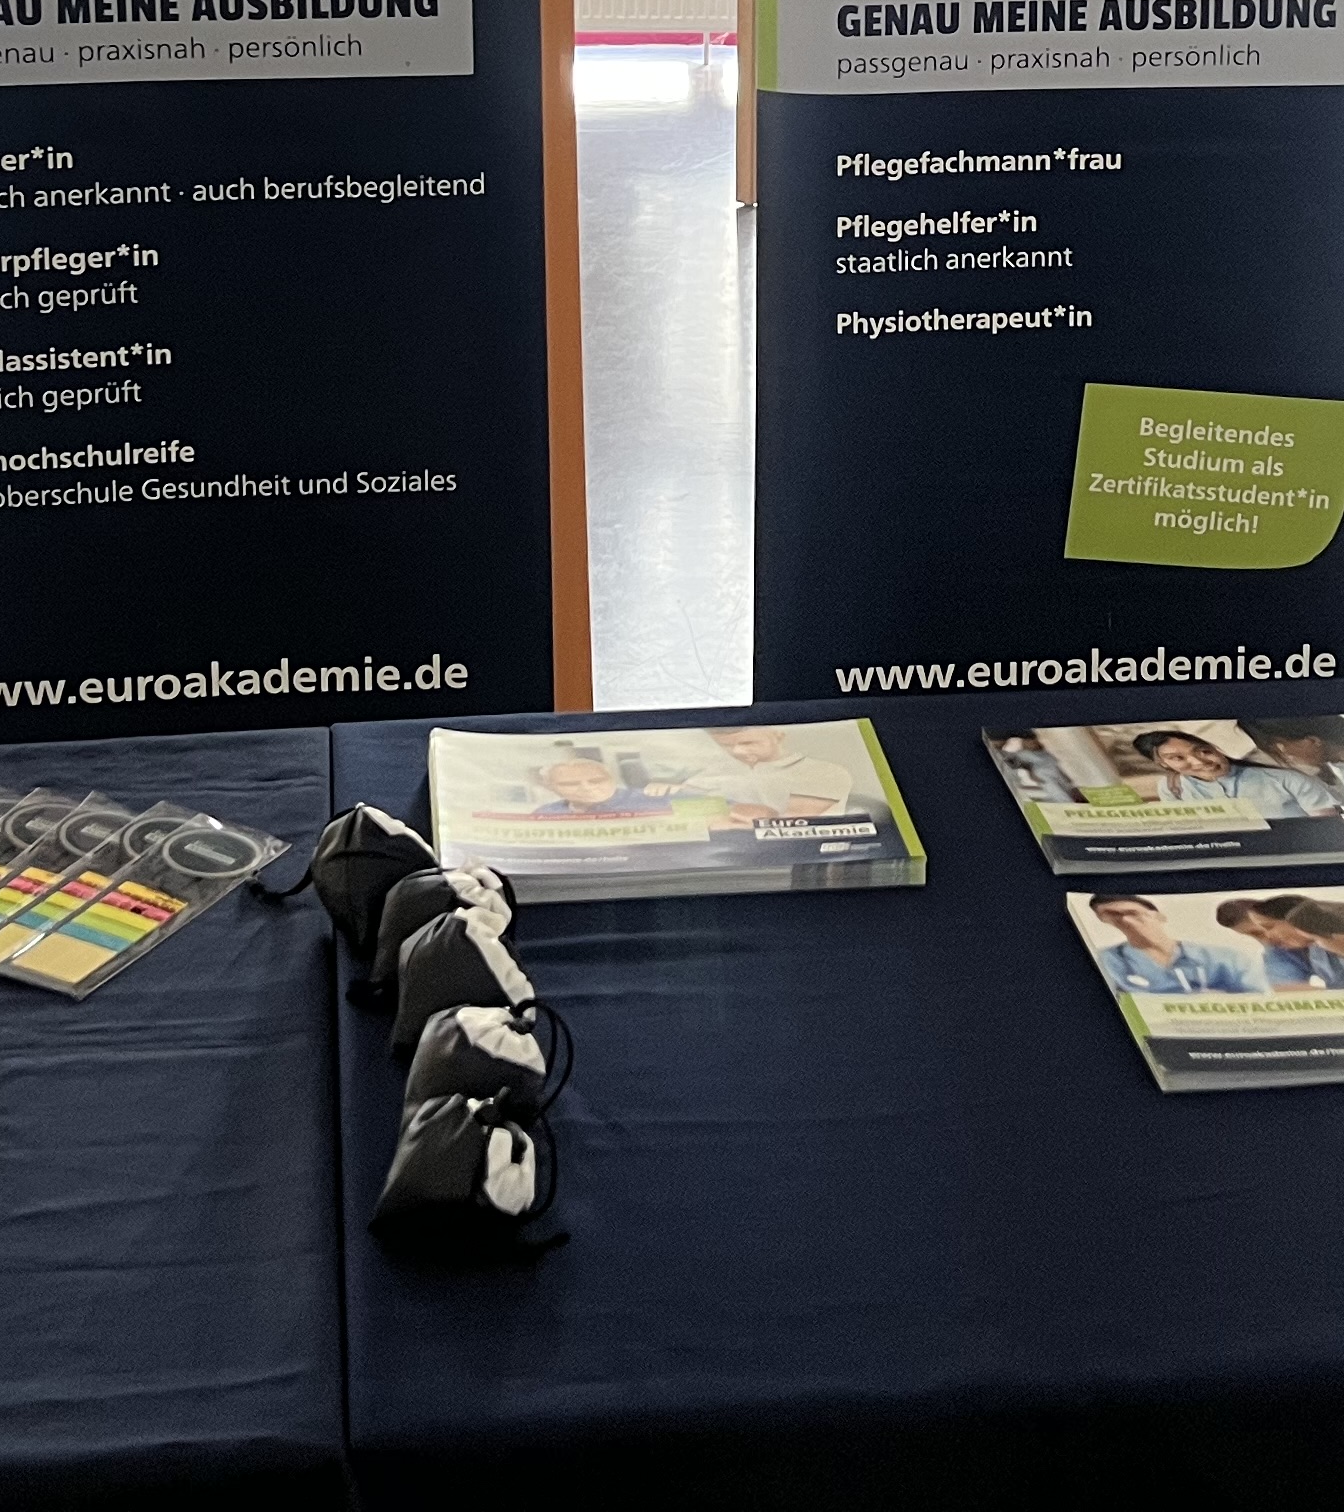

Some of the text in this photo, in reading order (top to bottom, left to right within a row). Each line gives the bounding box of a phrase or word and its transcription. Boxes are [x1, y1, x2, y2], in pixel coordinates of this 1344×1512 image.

[837, 1, 958, 38] GENAU
[973, 0, 1088, 34] MEINE
[77, 38, 205, 68] praxisnah
[228, 33, 362, 65] persönlich
[836, 43, 1260, 79] passgenau praxisnah persönlich
[33, 181, 171, 208] anerkannt
[192, 178, 255, 202] auch
[263, 172, 485, 205] berufsbegleitend
[836, 245, 1073, 275] staatlich anerkannt
[38, 281, 138, 314] geprüft
[41, 380, 142, 413] geprüft
[1139, 417, 1295, 450] Begleitendes
[1143, 446, 1284, 477] Studium als
[141, 473, 290, 501] Gesundheit
[298, 470, 349, 496] und
[356, 468, 457, 494] Soziales
[1154, 508, 1259, 540] möglich!
[836, 644, 1336, 693] www.euroakademie.de
[758, 818, 809, 828] Euro
[763, 825, 871, 839] Akademie
